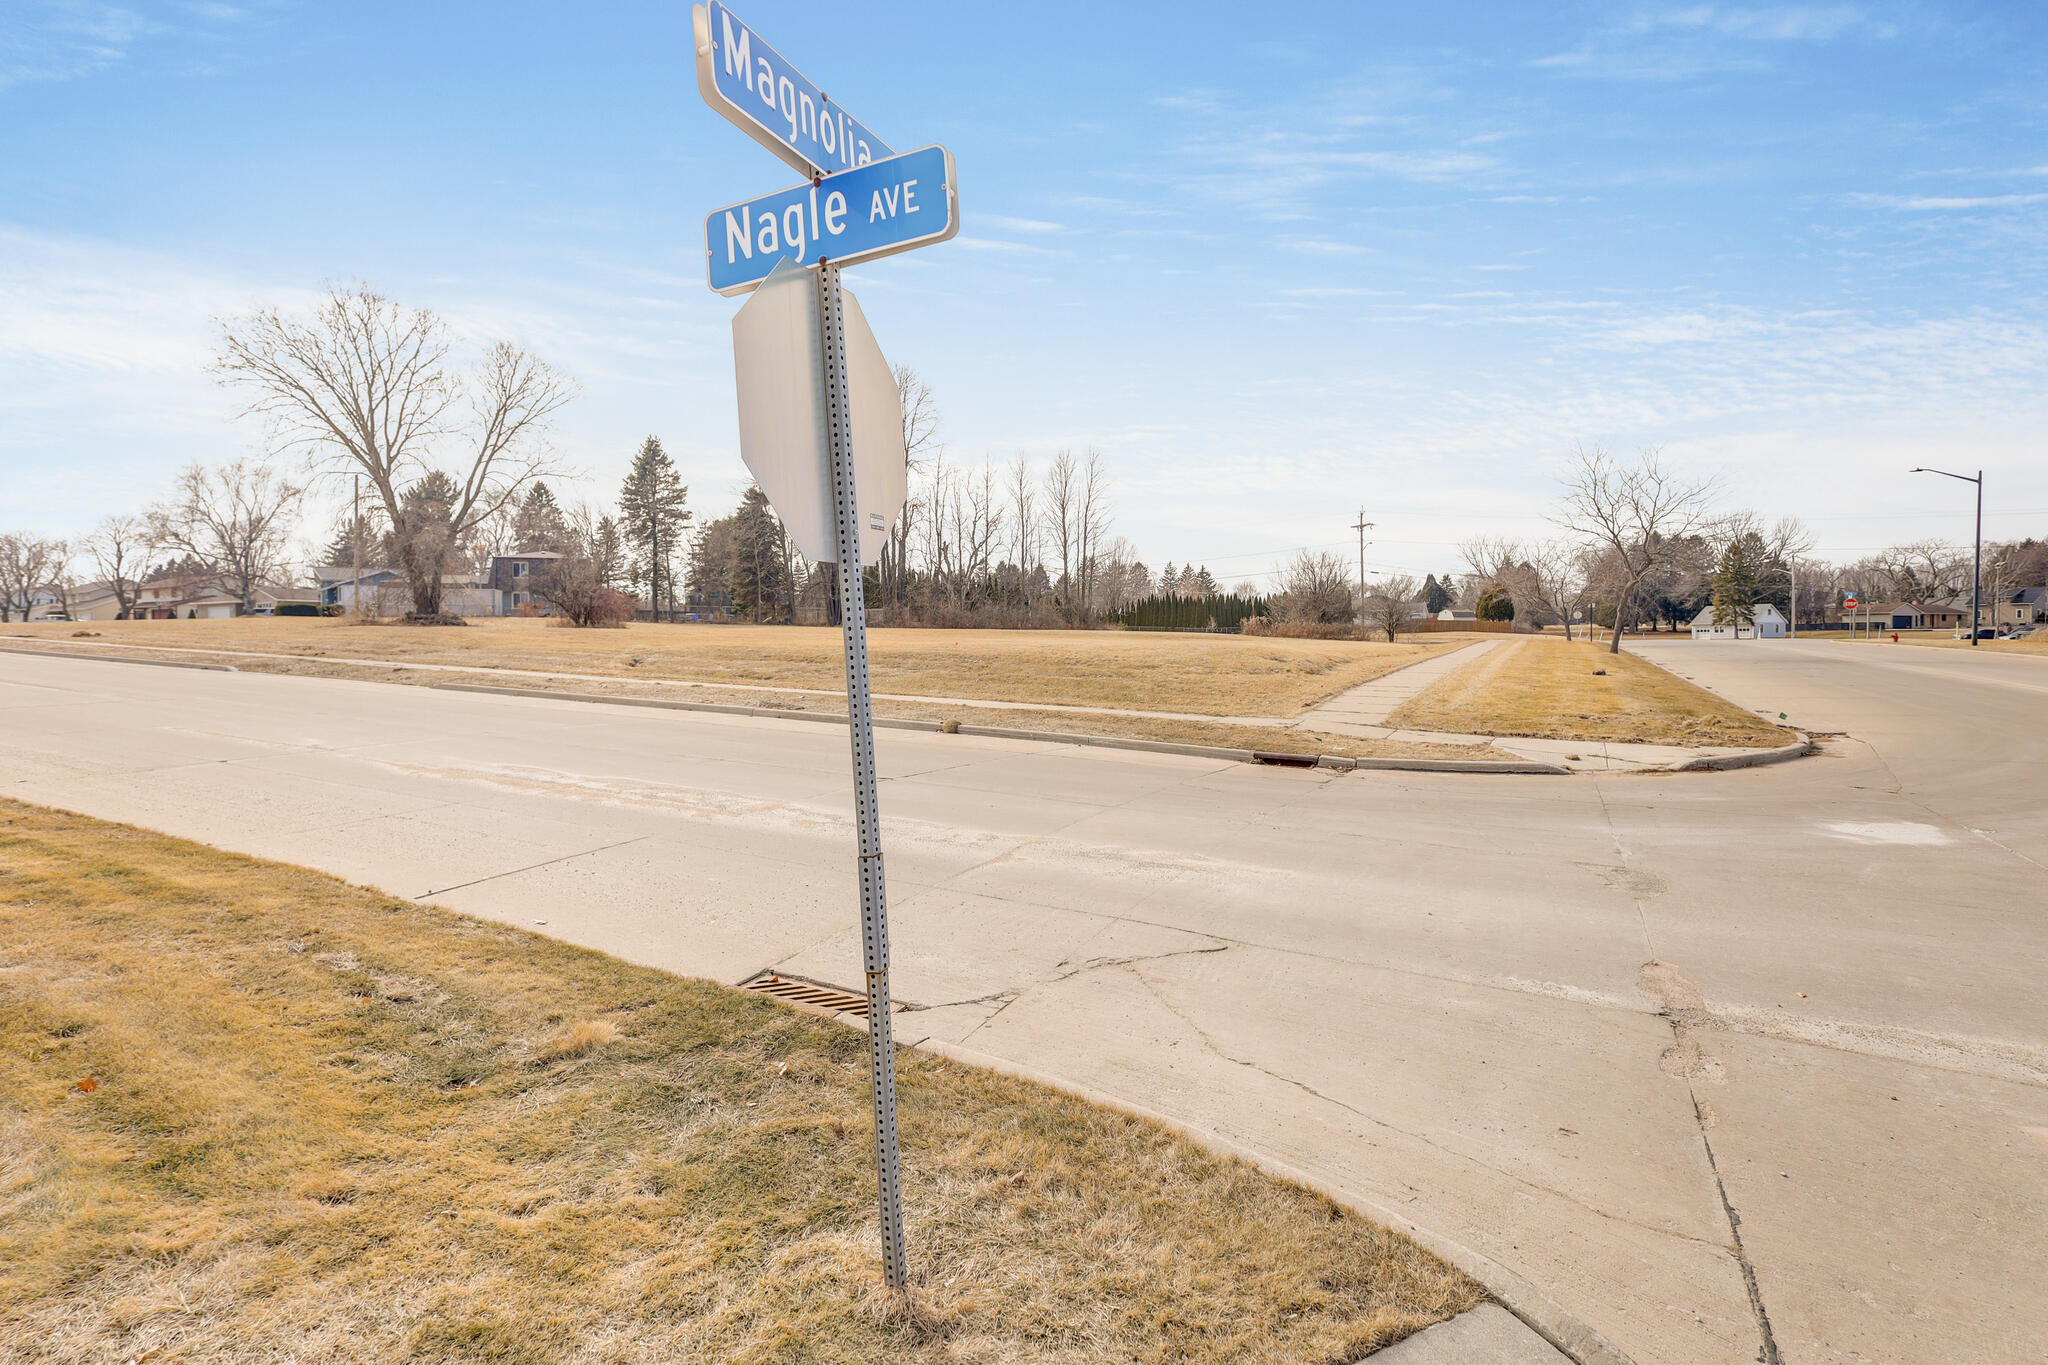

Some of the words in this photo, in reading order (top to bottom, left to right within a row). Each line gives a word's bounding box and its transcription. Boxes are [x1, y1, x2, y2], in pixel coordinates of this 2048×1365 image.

[721, 10, 872, 168] Magnolia
[725, 184, 847, 264] Nagle
[869, 179, 920, 224] AVE
